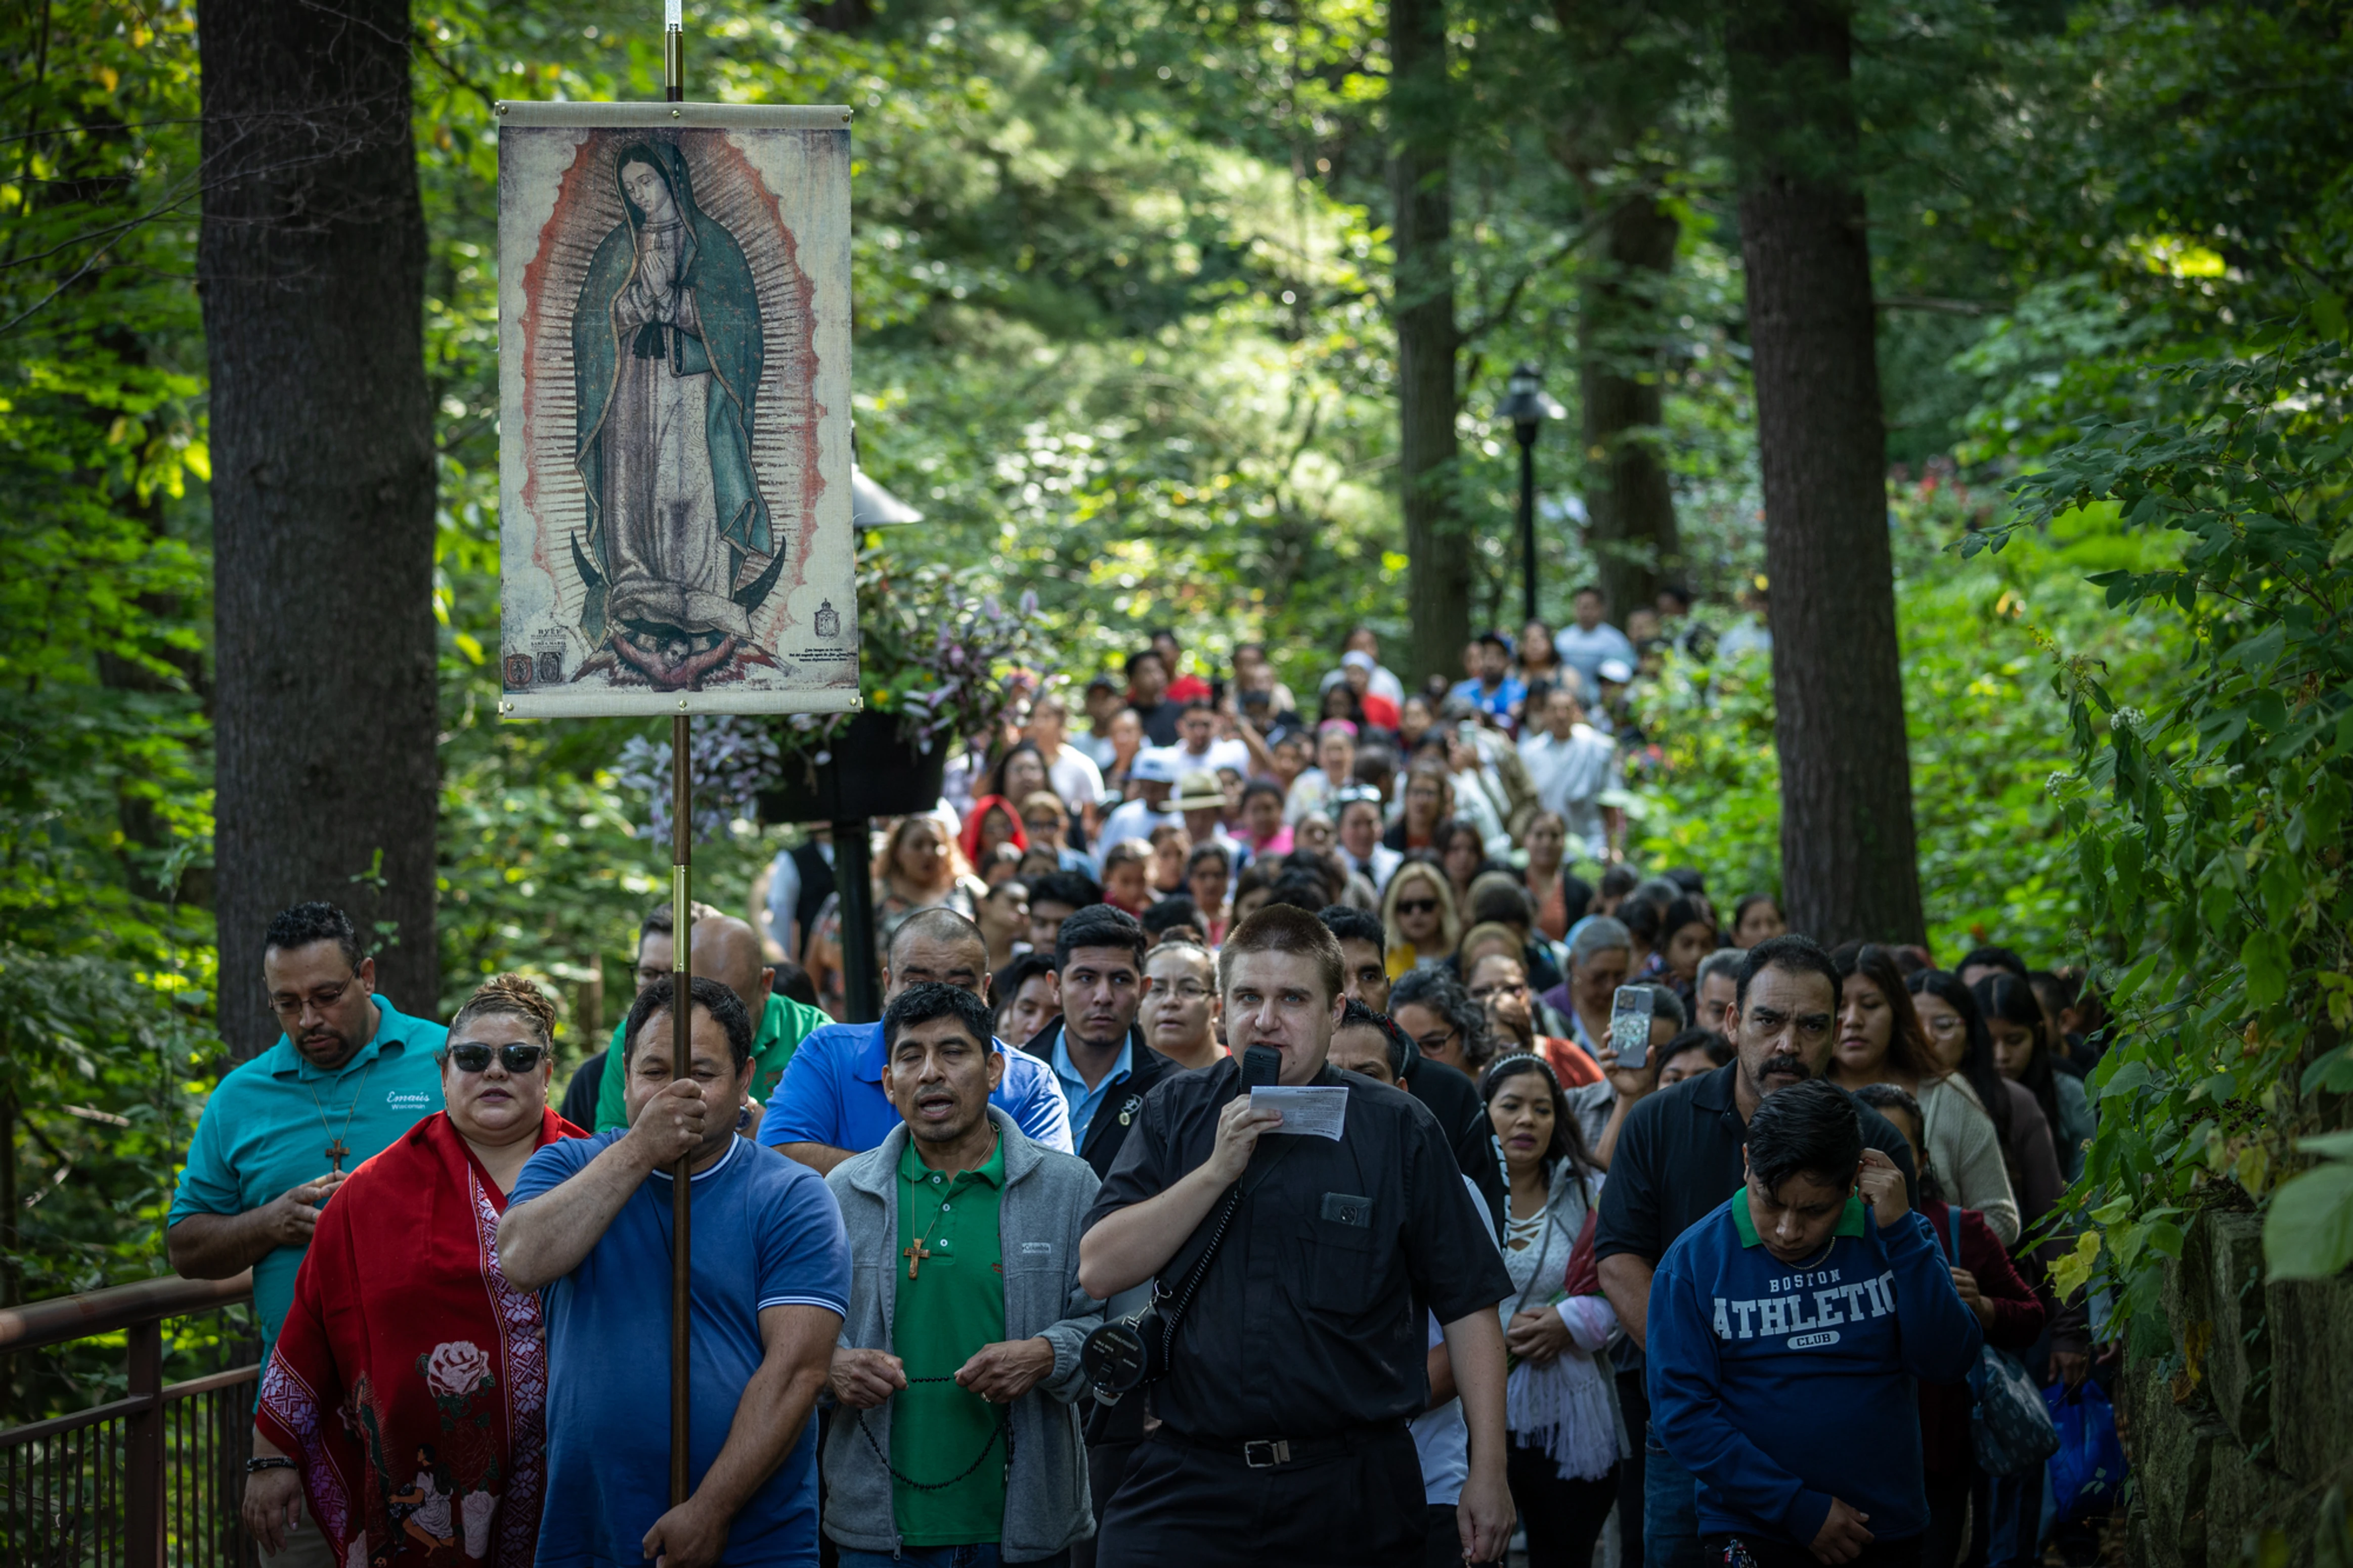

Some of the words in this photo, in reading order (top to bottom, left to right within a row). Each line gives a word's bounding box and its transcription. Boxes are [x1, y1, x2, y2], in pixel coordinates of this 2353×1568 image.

[386, 1091, 430, 1103] Emaús
[1770, 1269, 1841, 1292] BOSTON
[1713, 1269, 1896, 1339] ATHLETIC
[1796, 1333, 1832, 1347] CLUB
